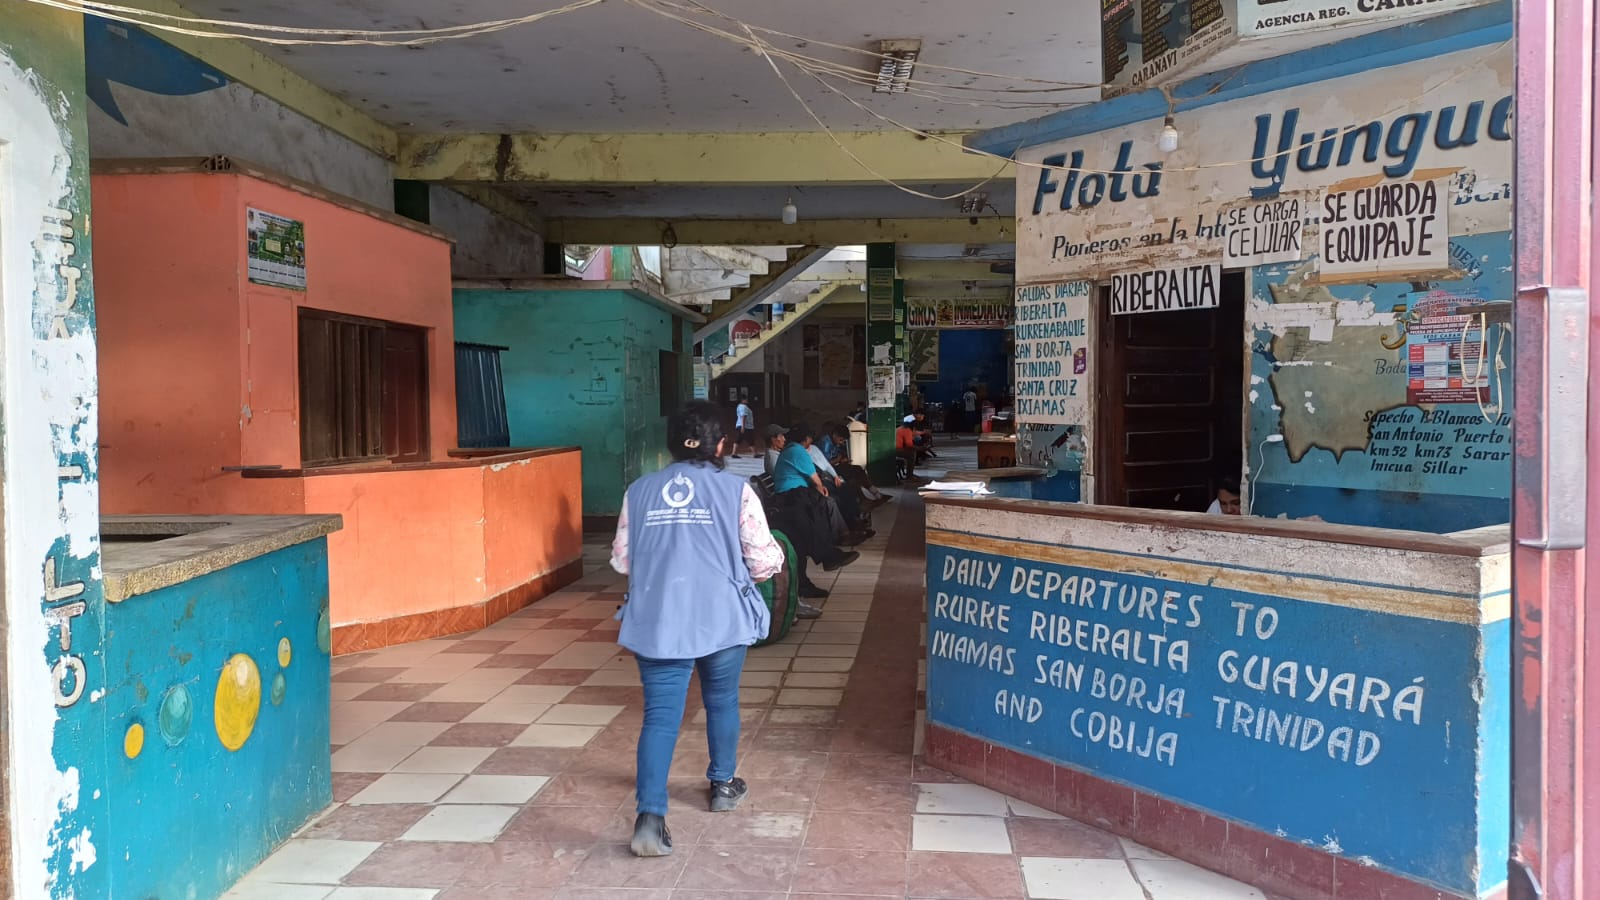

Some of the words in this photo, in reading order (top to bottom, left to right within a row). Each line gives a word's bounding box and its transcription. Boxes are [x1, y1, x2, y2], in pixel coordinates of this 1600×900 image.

[1256, 11, 1315, 29] AGENCIA
[1318, 7, 1350, 20] REG.
[1132, 50, 1177, 86] CARANAVI
[1228, 207, 1246, 226] SE
[1253, 199, 1299, 224] CARGA
[1322, 192, 1347, 224] SE
[1354, 180, 1437, 220] GUARDA
[1051, 235, 1131, 259] Pioneros
[1140, 230, 1162, 246] en
[1229, 220, 1301, 258] CELULAR
[1324, 215, 1436, 264] EQUIPAJE
[1017, 285, 1051, 302] SALIDAS
[1055, 281, 1089, 298] DIARIAS
[1112, 264, 1217, 313] RIBERALTA
[1015, 302, 1067, 321] RIBERALTA
[1016, 319, 1086, 340] RURRENABAQUE
[1015, 343, 1031, 359] SAN
[1036, 341, 1072, 357] BORJA
[1016, 361, 1061, 377] TRINIDAD
[1017, 380, 1045, 396] SANTA
[1050, 379, 1077, 396] CRUZ
[1017, 399, 1066, 416] IXIAMAS
[1363, 410, 1414, 428] Sapecho
[1367, 425, 1390, 441] San
[1392, 427, 1443, 442] Antonio
[1454, 428, 1504, 444] Puerto
[1422, 461, 1468, 475] Sillar
[942, 554, 1001, 591] DAILY
[1009, 566, 1204, 628] DEPARTURES
[1231, 602, 1279, 640] TO
[1030, 610, 1189, 674] RIBERALTA
[1218, 649, 1425, 726] GUAYARÁ
[932, 630, 1017, 676] IXIAMAS
[1034, 655, 1084, 693] SAN
[1091, 667, 1186, 719] BORJA
[1212, 695, 1381, 767] TRINIDAD
[995, 689, 1043, 724] AND
[1070, 707, 1179, 767] COBIJA
